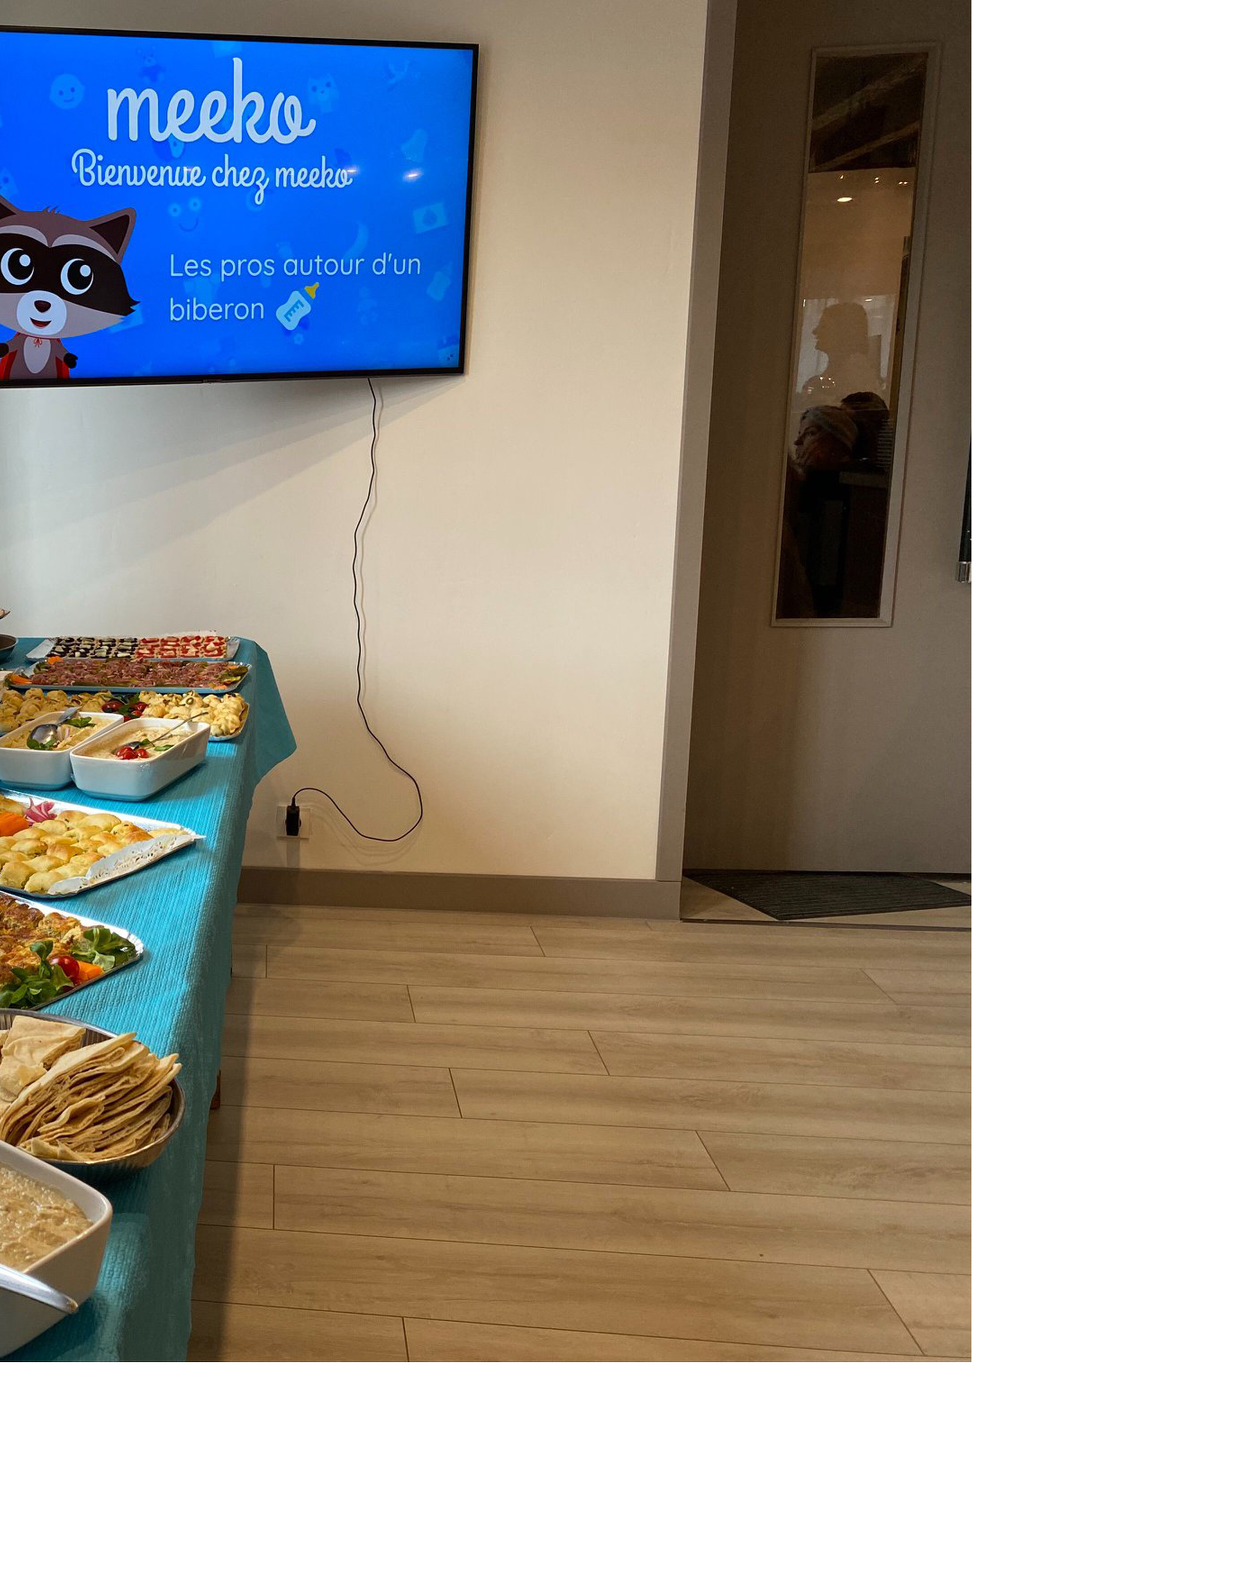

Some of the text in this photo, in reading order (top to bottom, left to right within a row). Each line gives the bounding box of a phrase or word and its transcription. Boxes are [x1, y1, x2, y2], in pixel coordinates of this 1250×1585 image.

[106, 57, 316, 144] meeko
[71, 148, 353, 205] Bienvenue chez meeko
[169, 252, 421, 289] Les pros autour d'un
[168, 298, 264, 322] biberon
